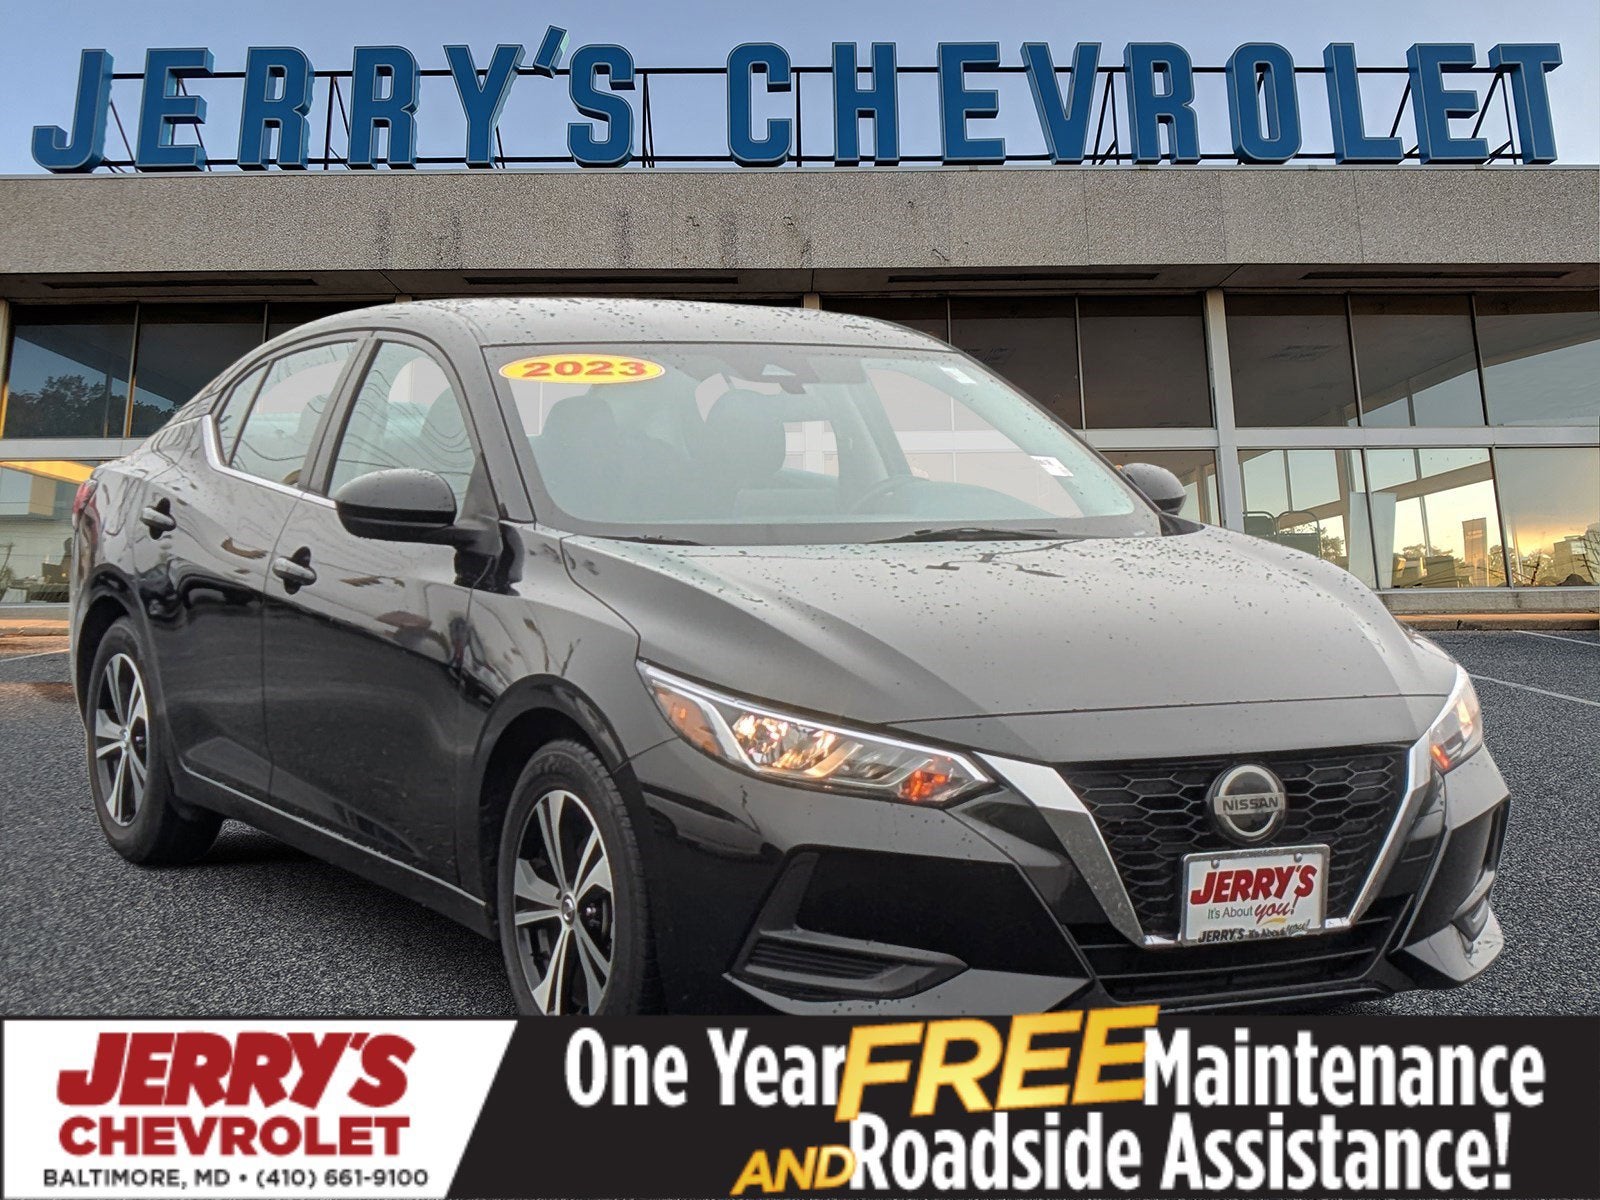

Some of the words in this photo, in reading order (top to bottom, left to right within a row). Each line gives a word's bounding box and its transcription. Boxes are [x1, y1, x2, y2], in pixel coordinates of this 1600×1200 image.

[31, 26, 636, 172] JERRY'S
[726, 41, 1562, 166] CHEVROLET
[522, 360, 647, 377] 2023
[1222, 797, 1279, 811] NISSAN
[1191, 865, 1317, 904] JERRY'S
[1207, 908, 1221, 920] It's
[1223, 902, 1253, 917] About
[1254, 896, 1298, 924] you!
[1198, 928, 1246, 943] JERRY'S
